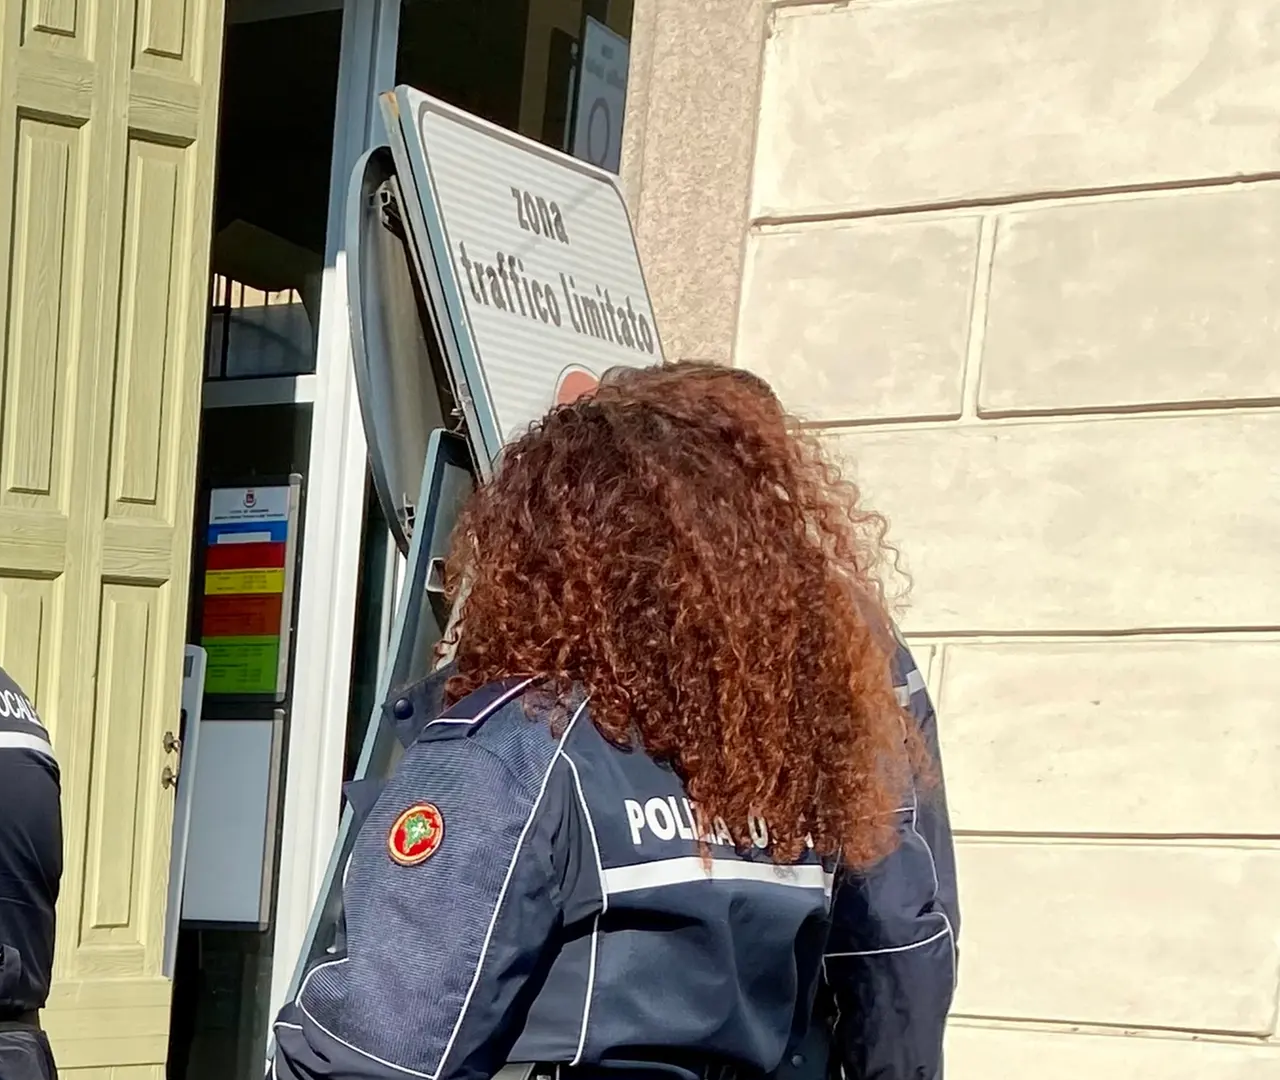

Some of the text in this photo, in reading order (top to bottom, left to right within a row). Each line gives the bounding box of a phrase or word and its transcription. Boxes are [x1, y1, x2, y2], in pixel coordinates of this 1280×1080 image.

[510, 186, 570, 245] zona
[459, 240, 654, 355] traffico limitato
